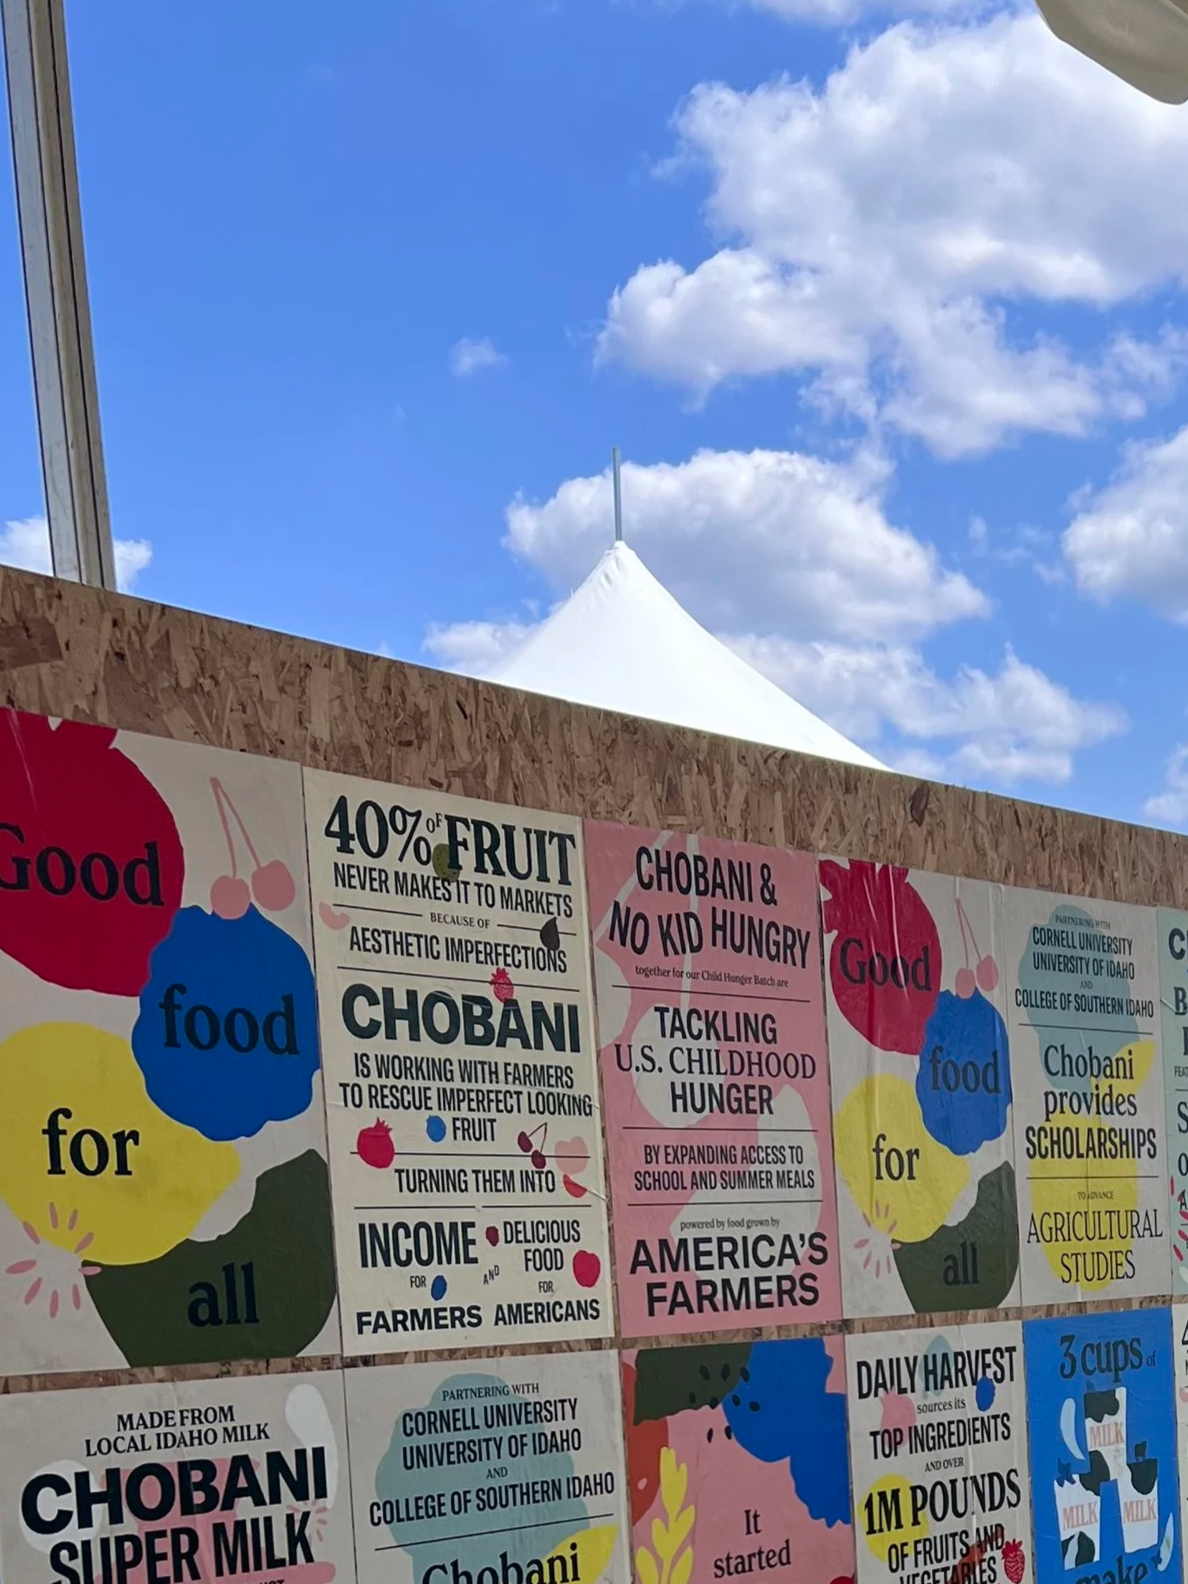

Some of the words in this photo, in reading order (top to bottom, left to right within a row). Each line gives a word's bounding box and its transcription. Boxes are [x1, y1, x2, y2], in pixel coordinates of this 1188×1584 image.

[324, 795, 432, 866] 40%
[426, 812, 442, 833] OF
[444, 814, 576, 886] FRUIT
[0, 823, 164, 906] Good
[635, 846, 754, 902] CHOBANI
[760, 863, 777, 906] &
[334, 862, 390, 894] NEVER
[394, 870, 451, 901] MAKES
[456, 880, 469, 904] IT
[474, 883, 495, 908] TO
[500, 886, 572, 918] MARKETS
[430, 912, 474, 928] BECAUSE
[478, 918, 490, 928] OF
[608, 900, 650, 955] NO
[657, 911, 702, 957] KID
[711, 907, 810, 969] HUNGRY
[1032, 926, 1076, 948] CORNELL
[1079, 932, 1133, 956] UNIVERSITY
[350, 926, 440, 960] AESTHETIC
[446, 938, 567, 973] IMPERFECTIONS
[840, 938, 931, 991] Good
[635, 966, 670, 977] together
[672, 968, 683, 978] for
[686, 971, 699, 980] our
[702, 971, 722, 982] Child
[724, 972, 752, 985] Hunger
[754, 975, 774, 987] Batch
[776, 979, 788, 987] are
[158, 984, 300, 1055] food
[342, 983, 580, 1052] CHOBANI
[654, 1006, 777, 1044] TACKLING
[614, 1044, 663, 1073] U.S.
[669, 1046, 815, 1079] CHILDHOOD
[930, 1045, 1000, 1094] food
[1044, 1044, 1134, 1080] Chobani
[670, 1081, 774, 1115] HUNGER
[1044, 1084, 1137, 1121] provides
[42, 1108, 140, 1176] for
[872, 1134, 920, 1181] for
[1026, 1125, 1157, 1159] SCHOLARSHIPS
[358, 1222, 478, 1268] INCOME
[504, 1220, 580, 1244] DELICIOUS
[1027, 1209, 1163, 1244] AGRICULTURAL
[524, 1248, 564, 1272] FOOD
[629, 1232, 828, 1275] AMERICA'S
[943, 1241, 979, 1286] all
[1061, 1250, 1135, 1284] STUDIES
[187, 1262, 258, 1327] all
[494, 1298, 600, 1326] AMERICANS
[646, 1272, 819, 1317] FARMERS
[356, 1304, 482, 1334] FARMERS
[856, 1355, 918, 1400] DAILY
[924, 1346, 1017, 1392] HARVEST
[1060, 1334, 1076, 1380] 3
[1081, 1336, 1144, 1384] cups
[1146, 1351, 1156, 1368] of
[917, 1401, 952, 1414] sources
[954, 1398, 965, 1409] its
[870, 1428, 903, 1460] TOP
[909, 1412, 1011, 1454] INGREDIENTS
[1089, 1421, 1125, 1448] MILK
[21, 1446, 328, 1535] CHOBANI
[370, 1494, 446, 1527] COLLEGE
[451, 1490, 471, 1515] OF
[476, 1478, 561, 1512] SOUTHERN
[567, 1471, 615, 1499] IDAHO
[864, 1488, 903, 1535] 1M
[910, 1468, 1021, 1527] POUNDS
[1123, 1498, 1157, 1524] MILK
[1062, 1501, 1098, 1530] MILK
[212, 1511, 314, 1578] MILK
[713, 1539, 791, 1579] started
